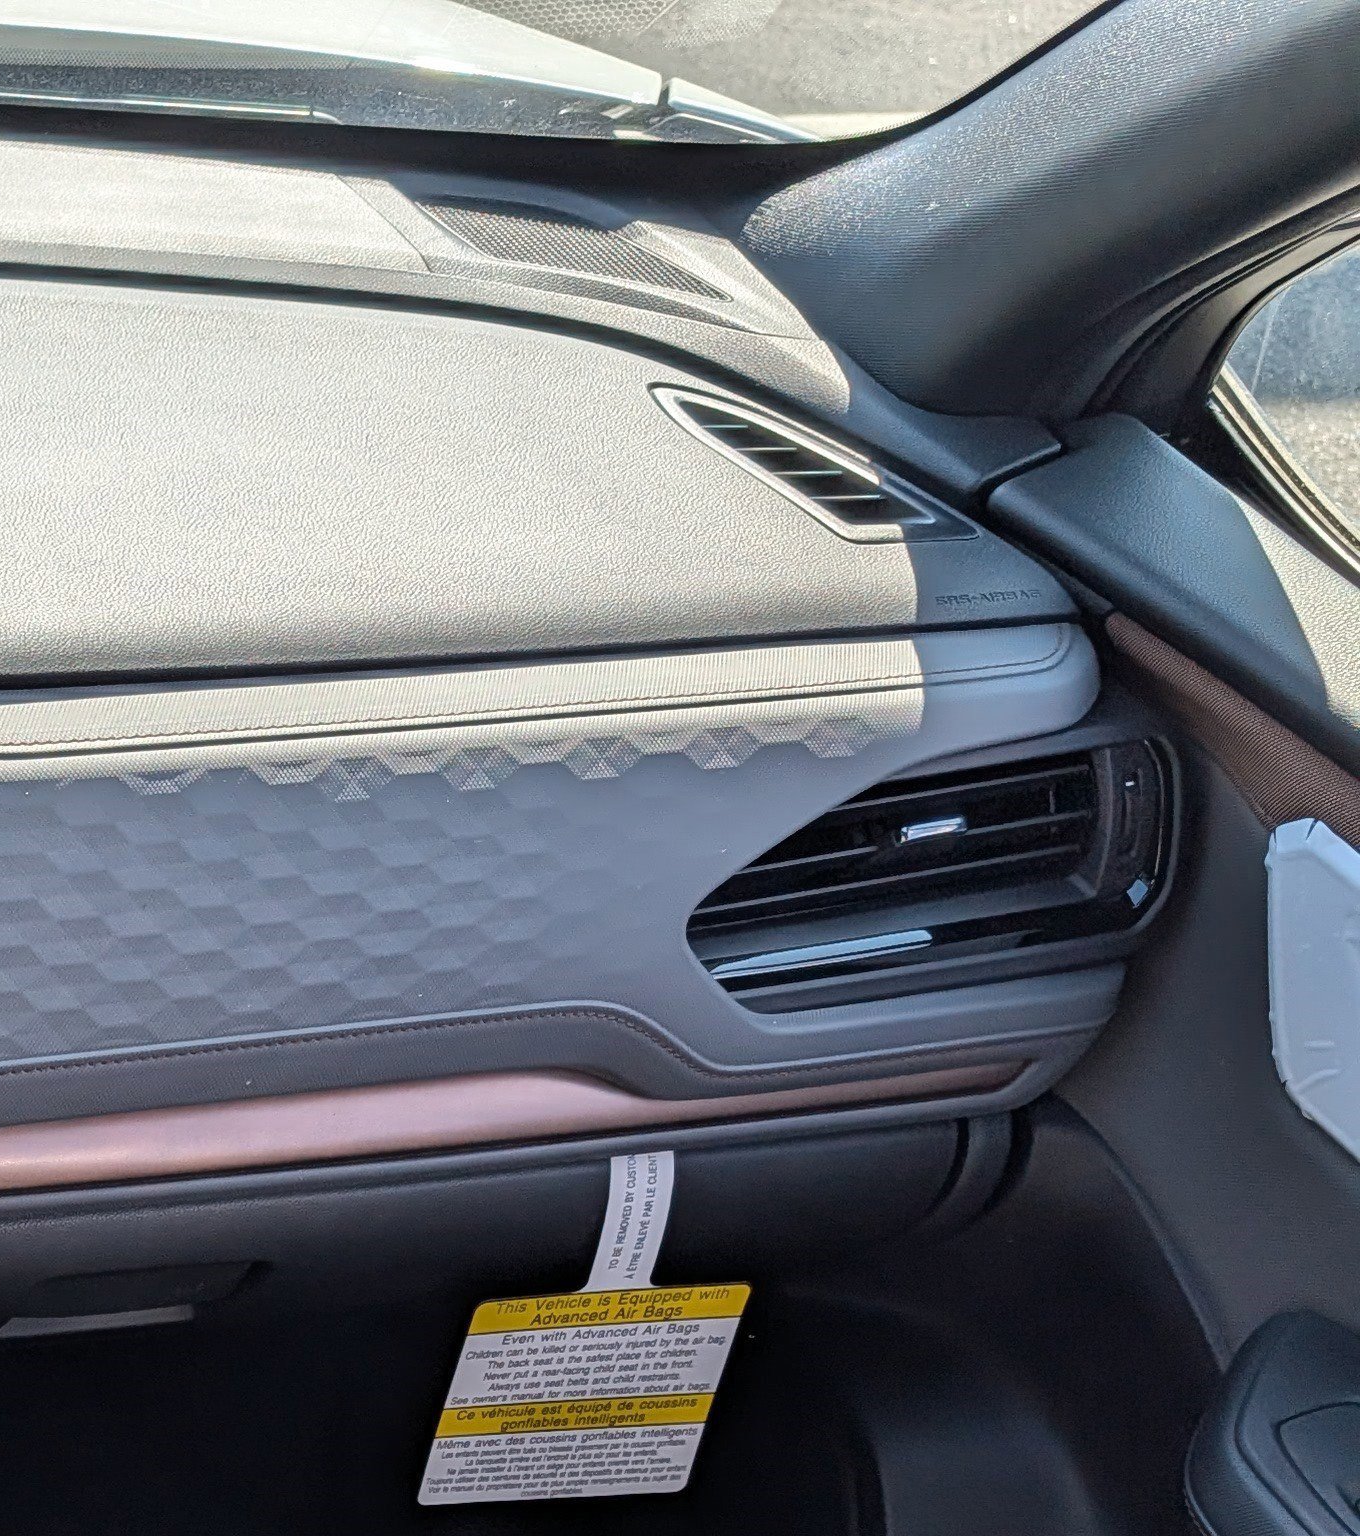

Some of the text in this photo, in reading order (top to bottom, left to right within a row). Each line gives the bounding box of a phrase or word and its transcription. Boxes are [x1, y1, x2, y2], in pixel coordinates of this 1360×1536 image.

[497, 1288, 729, 1314] This Vehicle is Equipped with
[530, 1305, 683, 1326] Advanced Air Bags
[502, 1324, 700, 1345] Even with Advanced Air Bags
[465, 1350, 503, 1360] Children
[542, 1345, 566, 1354] killed
[582, 1342, 622, 1351] seriously
[625, 1340, 657, 1350] injured
[456, 1397, 698, 1420] Ce véhicule est équipé de coussins
[500, 1412, 645, 1432] gonflables intelligents
[437, 1427, 698, 1450] Même avec des coussins gonflables intelligents
